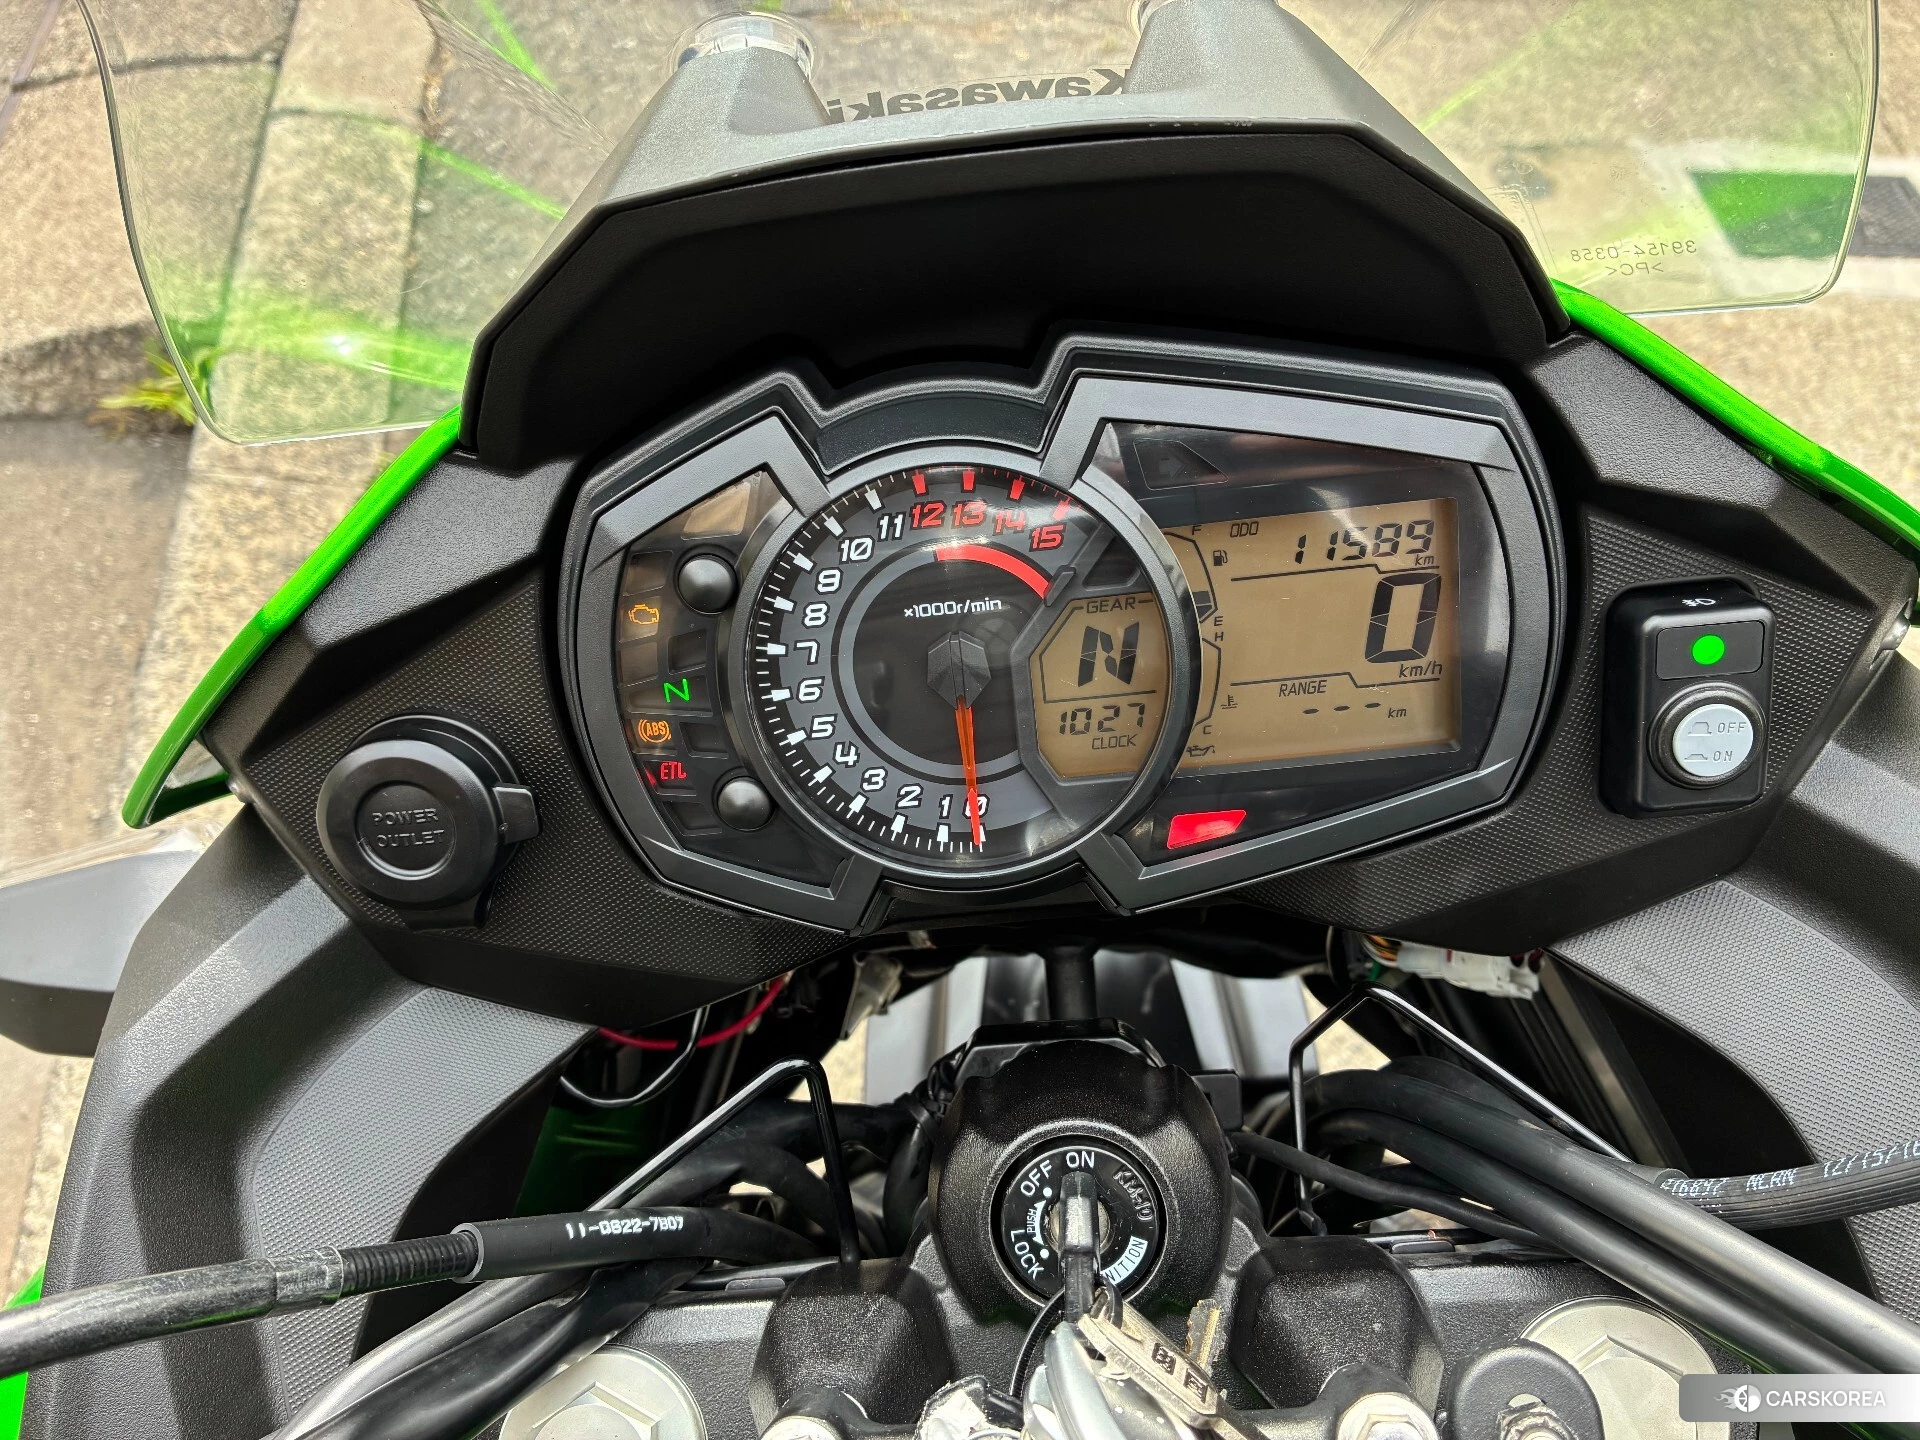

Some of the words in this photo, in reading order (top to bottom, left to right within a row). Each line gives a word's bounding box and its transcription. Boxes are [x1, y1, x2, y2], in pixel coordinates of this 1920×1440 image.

[910, 503, 945, 528] 12
[952, 502, 986, 525] 13
[993, 509, 1026, 535] 14
[877, 513, 905, 541] 11
[1030, 525, 1064, 550] 15
[1230, 521, 1259, 538] ODO
[839, 537, 875, 563] 10
[1295, 519, 1434, 564] 11589
[1414, 554, 1435, 566] km
[816, 569, 842, 593] 9
[803, 602, 828, 627] 8
[1086, 597, 1137, 614] GEAR
[1365, 572, 1442, 664] 0
[1214, 631, 1224, 641] H
[795, 641, 820, 664] 7
[1077, 621, 1140, 688] N
[1398, 663, 1442, 678] km/h
[663, 678, 690, 702] N
[797, 677, 825, 701] 6
[1278, 680, 1327, 697] RANGE
[1058, 702, 1146, 736] 1027
[1388, 707, 1407, 718] km
[646, 721, 666, 736] ABS
[810, 714, 837, 740] 5
[1716, 722, 1747, 733] OFF
[833, 741, 860, 766] 4
[1091, 733, 1138, 750] CLOCK
[1713, 750, 1733, 762] ON
[860, 767, 886, 792] 3
[897, 785, 923, 809] 2
[937, 796, 953, 817] 1
[372, 808, 439, 826] POWER
[376, 830, 444, 847] OUTLET
[1066, 1151, 1094, 1168] ON
[1020, 1160, 1053, 1196] OFF
[1026, 1208, 1037, 1233] PUSH
[1011, 1229, 1044, 1279] LOCK
